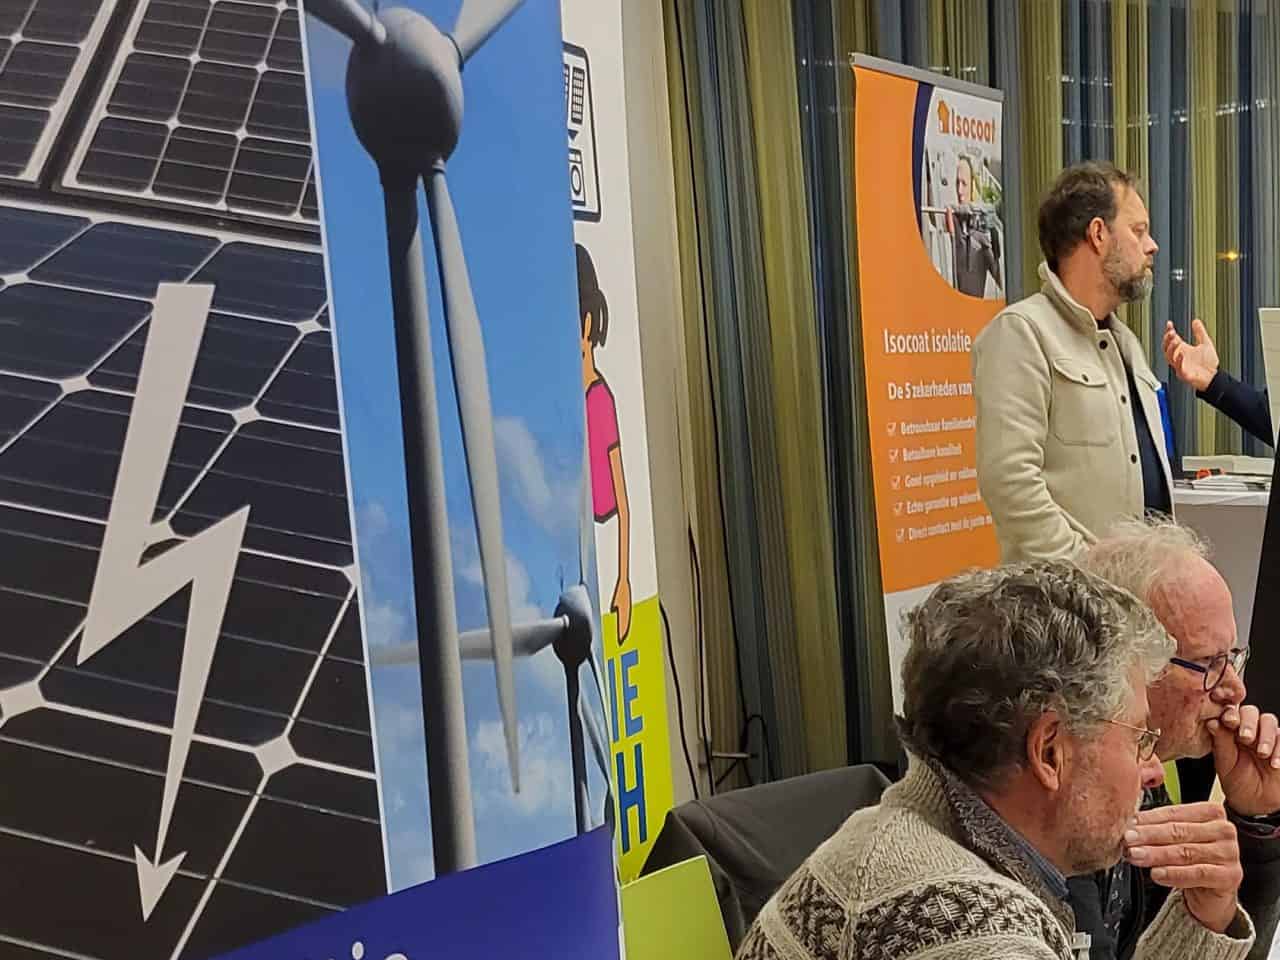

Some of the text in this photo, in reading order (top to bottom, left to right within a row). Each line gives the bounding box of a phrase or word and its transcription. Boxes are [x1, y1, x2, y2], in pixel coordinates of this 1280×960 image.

[951, 108, 996, 145] Isocoat
[884, 328, 972, 353] Isocoat isolatie
[888, 381, 904, 400] De
[905, 382, 912, 399] 5
[616, 742, 648, 855] H
